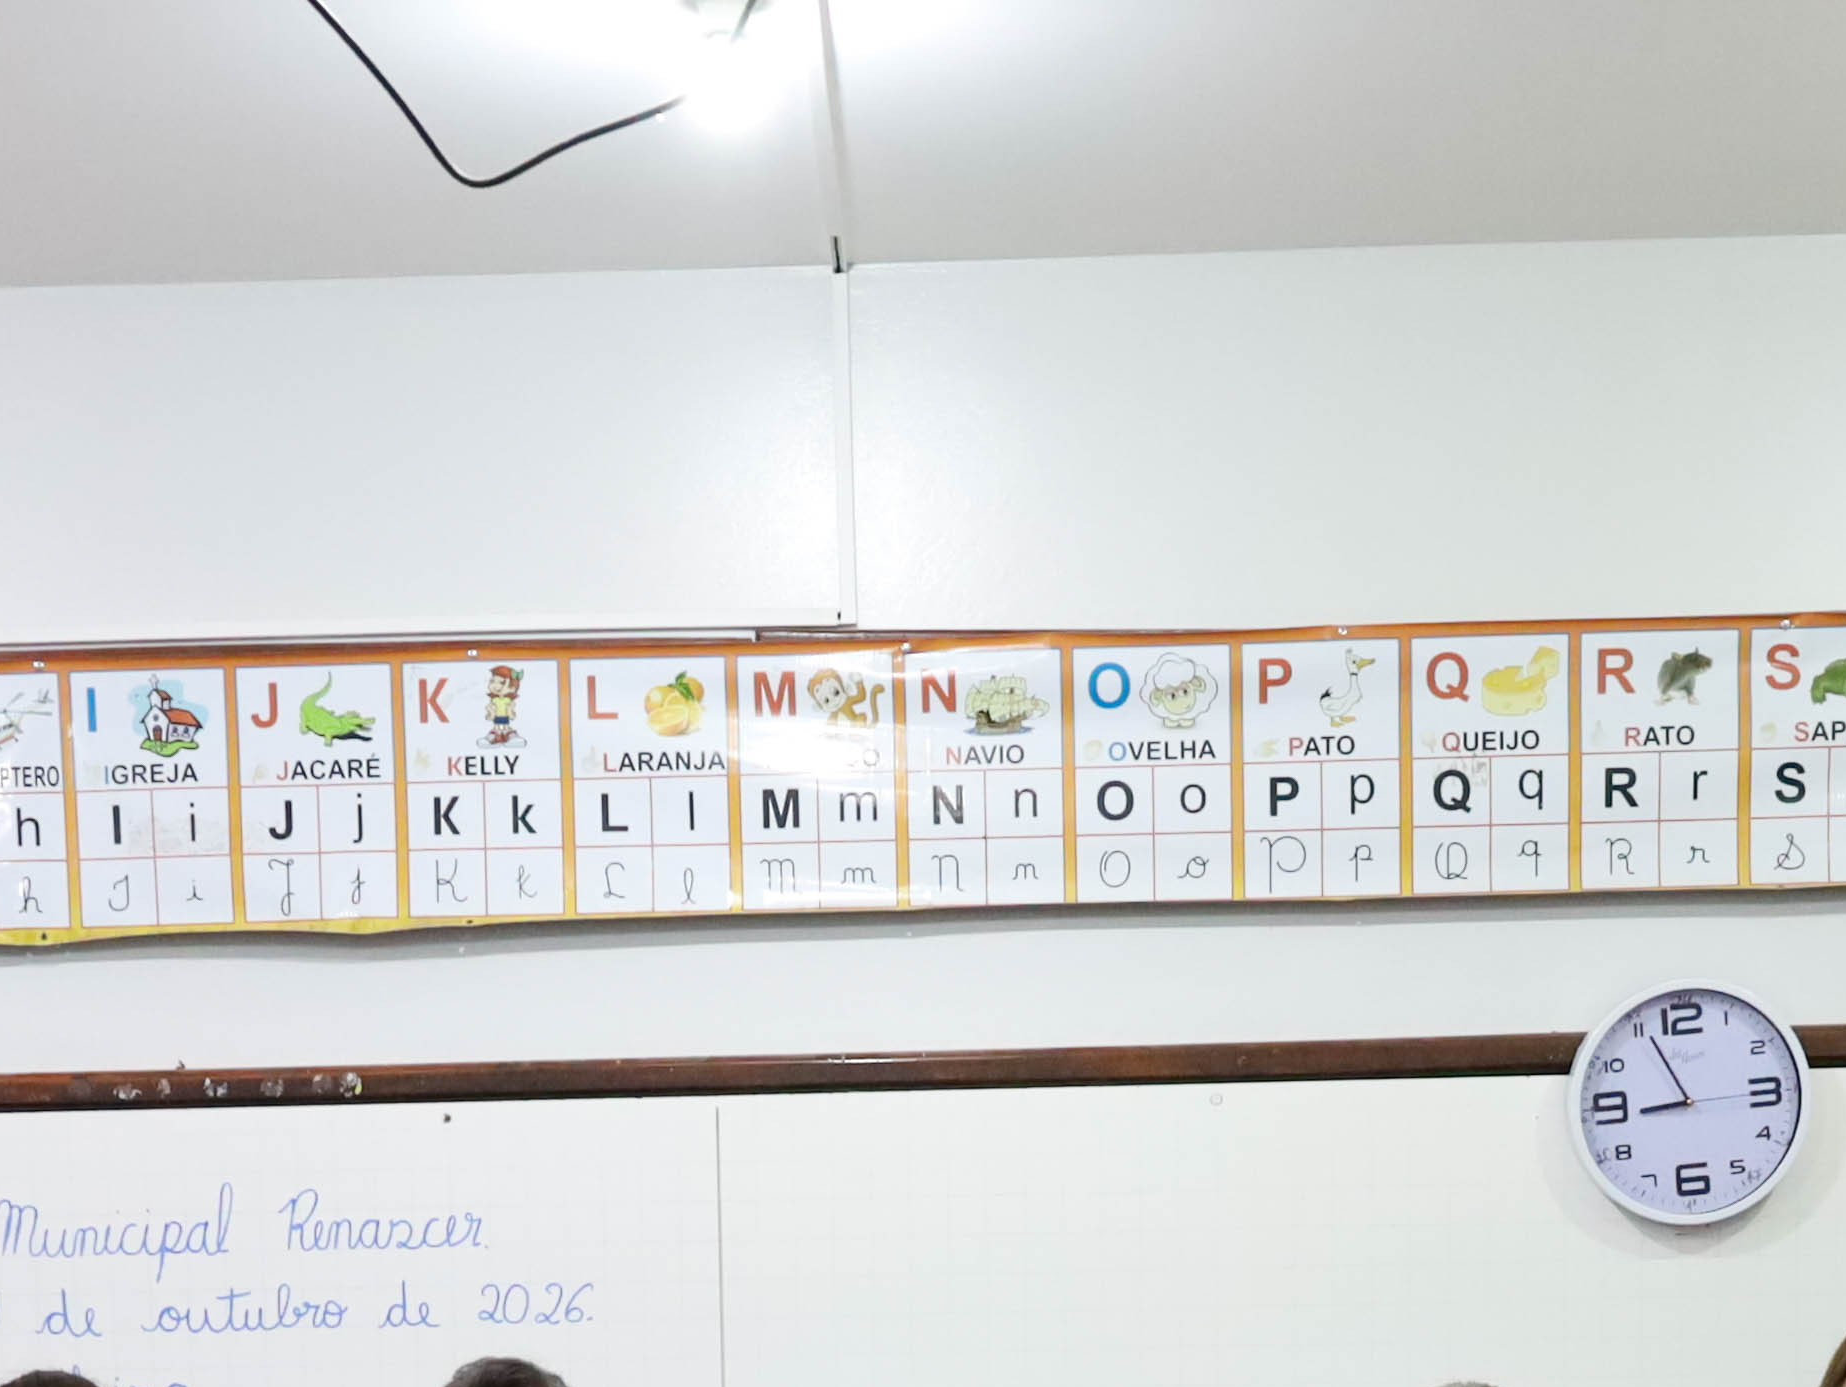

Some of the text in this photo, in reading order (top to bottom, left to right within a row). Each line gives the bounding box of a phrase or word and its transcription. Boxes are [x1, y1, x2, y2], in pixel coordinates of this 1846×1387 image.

[1260, 659, 1293, 703] P
[1426, 652, 1471, 703] Q
[1598, 648, 1635, 694] R
[1765, 642, 1801, 691] S
[588, 673, 617, 720] L
[757, 670, 797, 716] M
[921, 666, 957, 712] N
[1088, 661, 1130, 709] O
[87, 688, 97, 732] I
[250, 682, 277, 728] J
[417, 678, 450, 723] K
[1108, 738, 1216, 762] OVELHA
[1288, 734, 1356, 759] PATO
[1442, 727, 1541, 753] QUEIJO
[1624, 725, 1696, 748] RATO
[275, 754, 381, 784] JACARÉ
[447, 753, 519, 779] KELLY
[602, 748, 725, 773] LARANJA
[945, 743, 1025, 765] NAVIO
[103, 762, 198, 786] IGREJA
[1634, 1023, 1643, 1037] 11
[1661, 1002, 1703, 1036] 12
[1724, 1011, 1728, 1026] 1
[1750, 1040, 1765, 1054] 2
[1604, 1058, 1625, 1073] 10
[1748, 1077, 1782, 1108] 3
[1593, 1091, 1628, 1125] 9
[1755, 1126, 1771, 1140] 4
[1615, 1145, 1632, 1160] 8
[1729, 1160, 1746, 1174] 5
[1641, 1174, 1657, 1187] 7
[1675, 1162, 1711, 1196] 6
[35, 1286, 103, 1337] de
[141, 1284, 348, 1335] outubro
[377, 1280, 440, 1328] de
